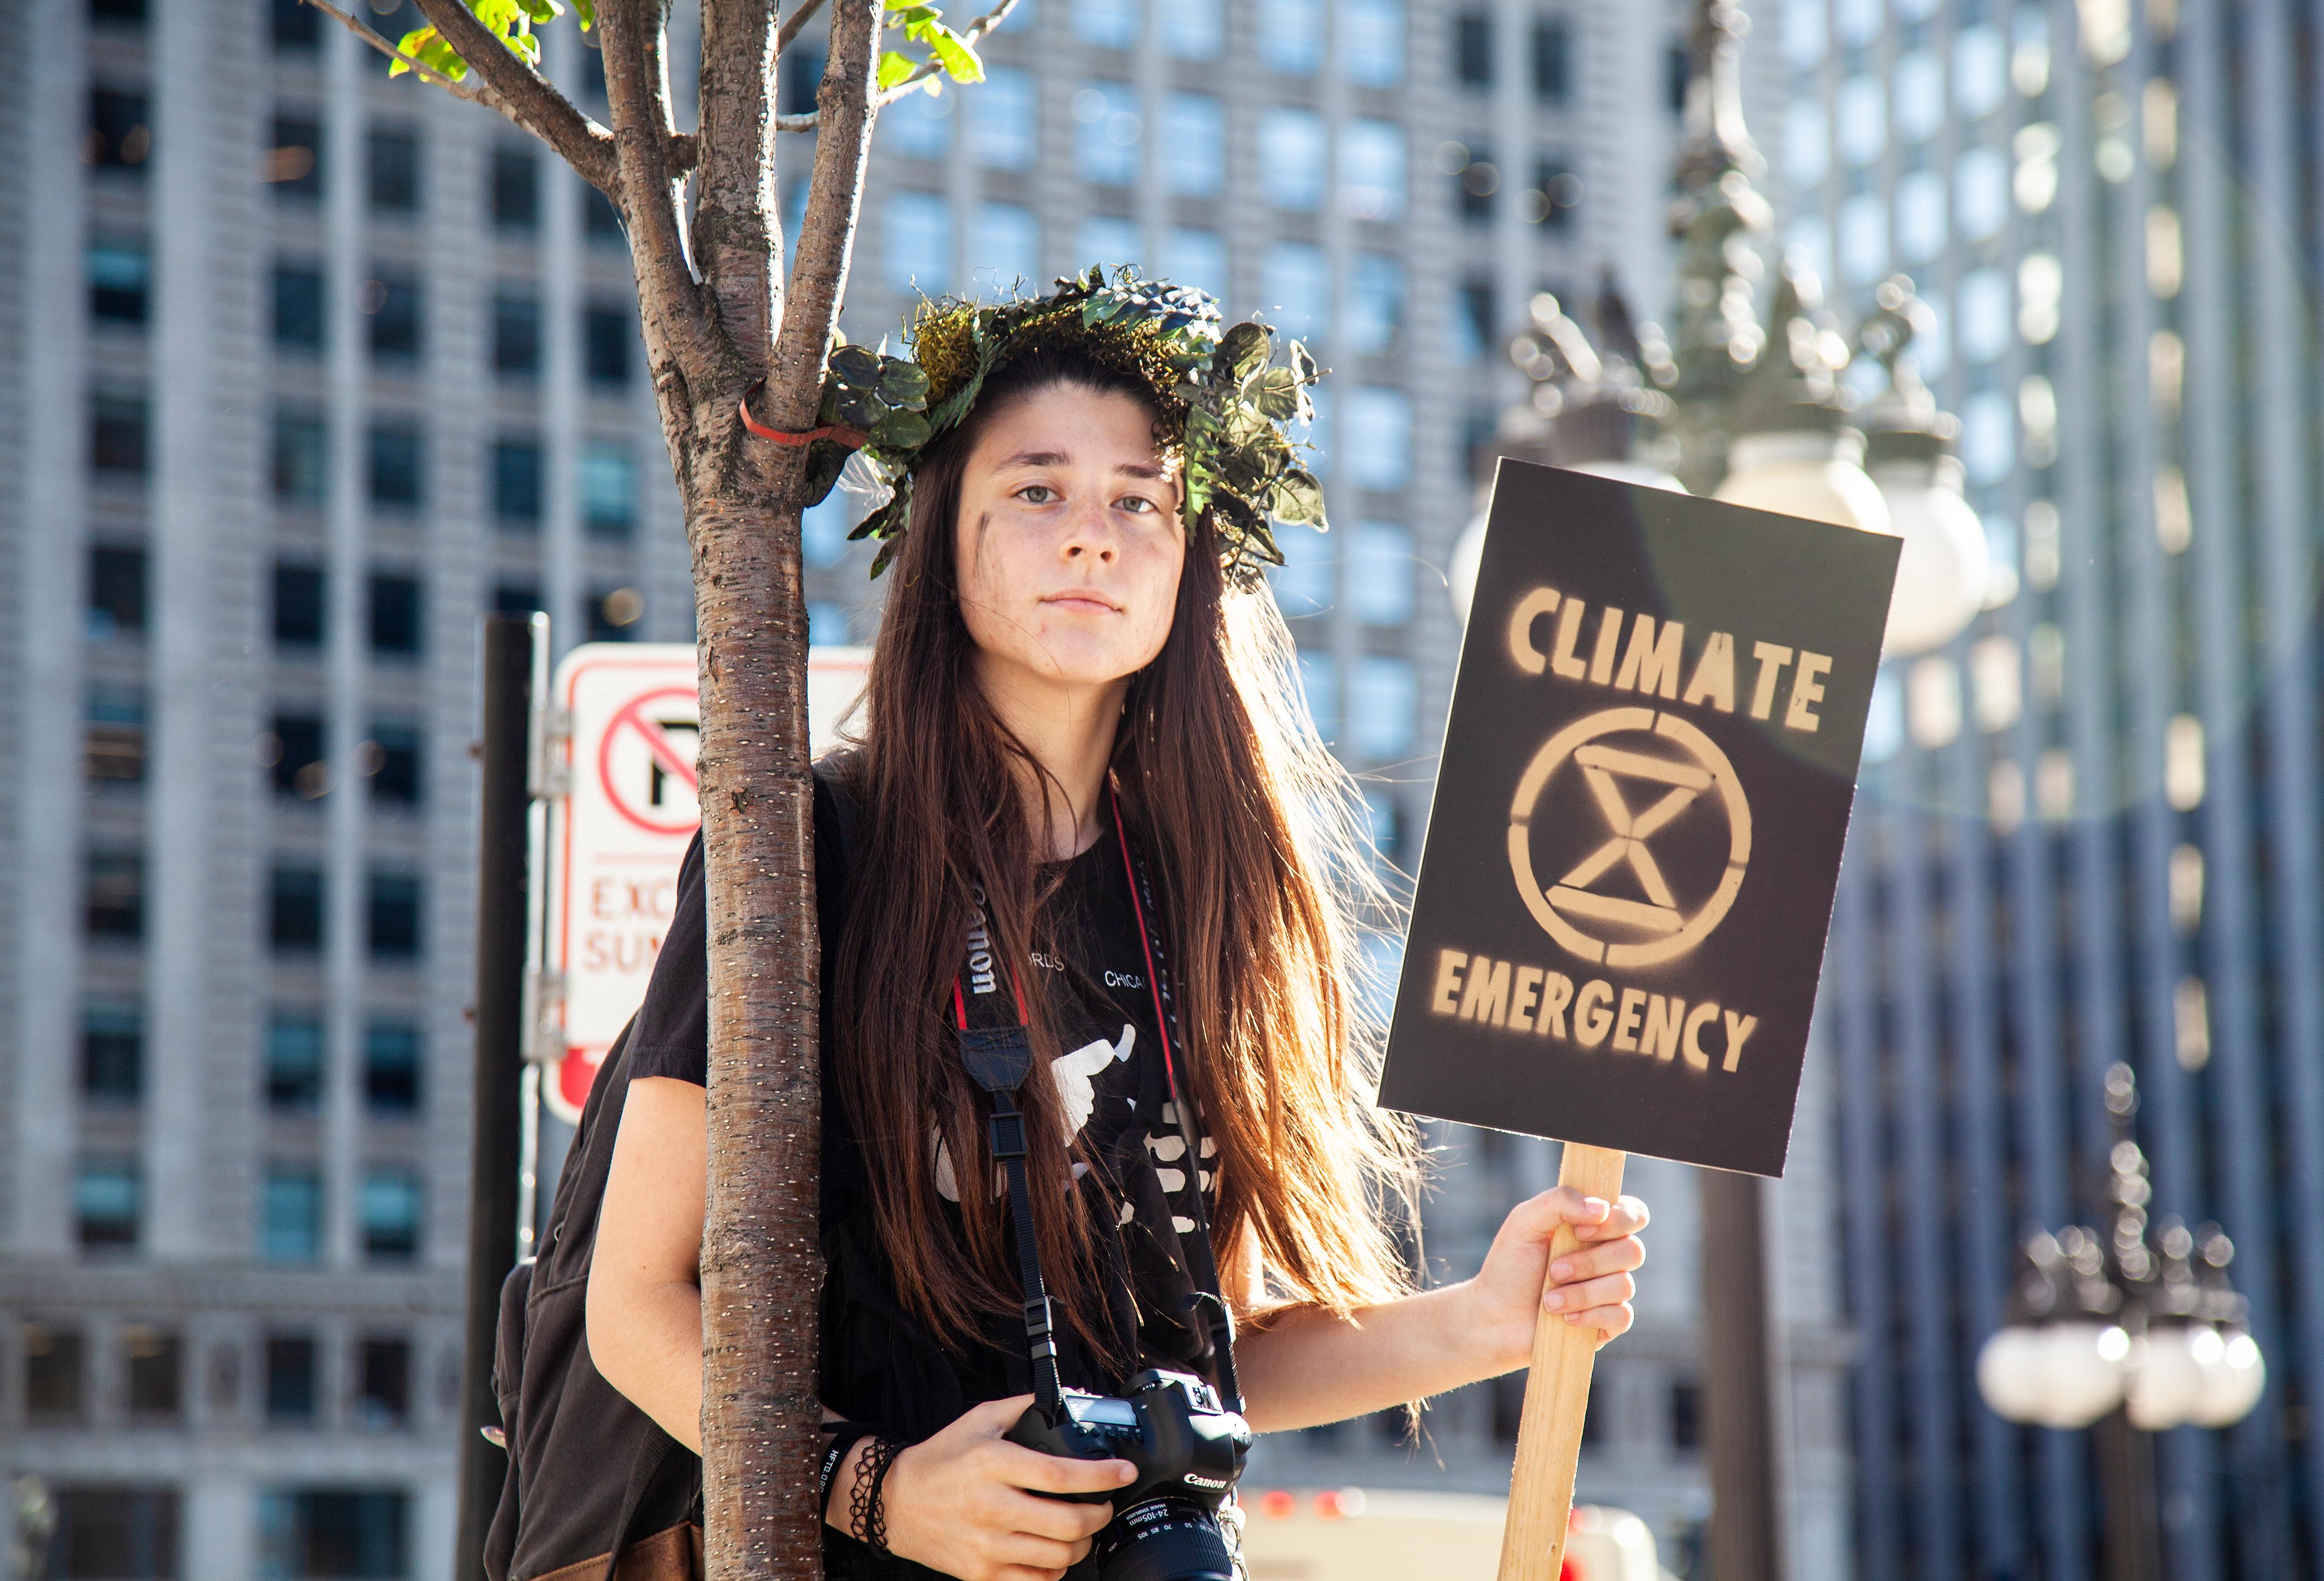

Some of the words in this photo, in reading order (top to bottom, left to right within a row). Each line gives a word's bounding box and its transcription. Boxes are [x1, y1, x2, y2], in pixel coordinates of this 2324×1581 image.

[1509, 586, 1833, 732] CLIMATE
[592, 877, 676, 918] EXC
[1028, 953, 1065, 972] RDS
[1105, 970, 1147, 989] CHICA
[1431, 948, 1759, 1073] EMERGENCY
[1184, 1473, 1227, 1489] Canon
[1129, 1509, 1169, 1526] 24-105mm
[1137, 1531, 1149, 1540] 105
